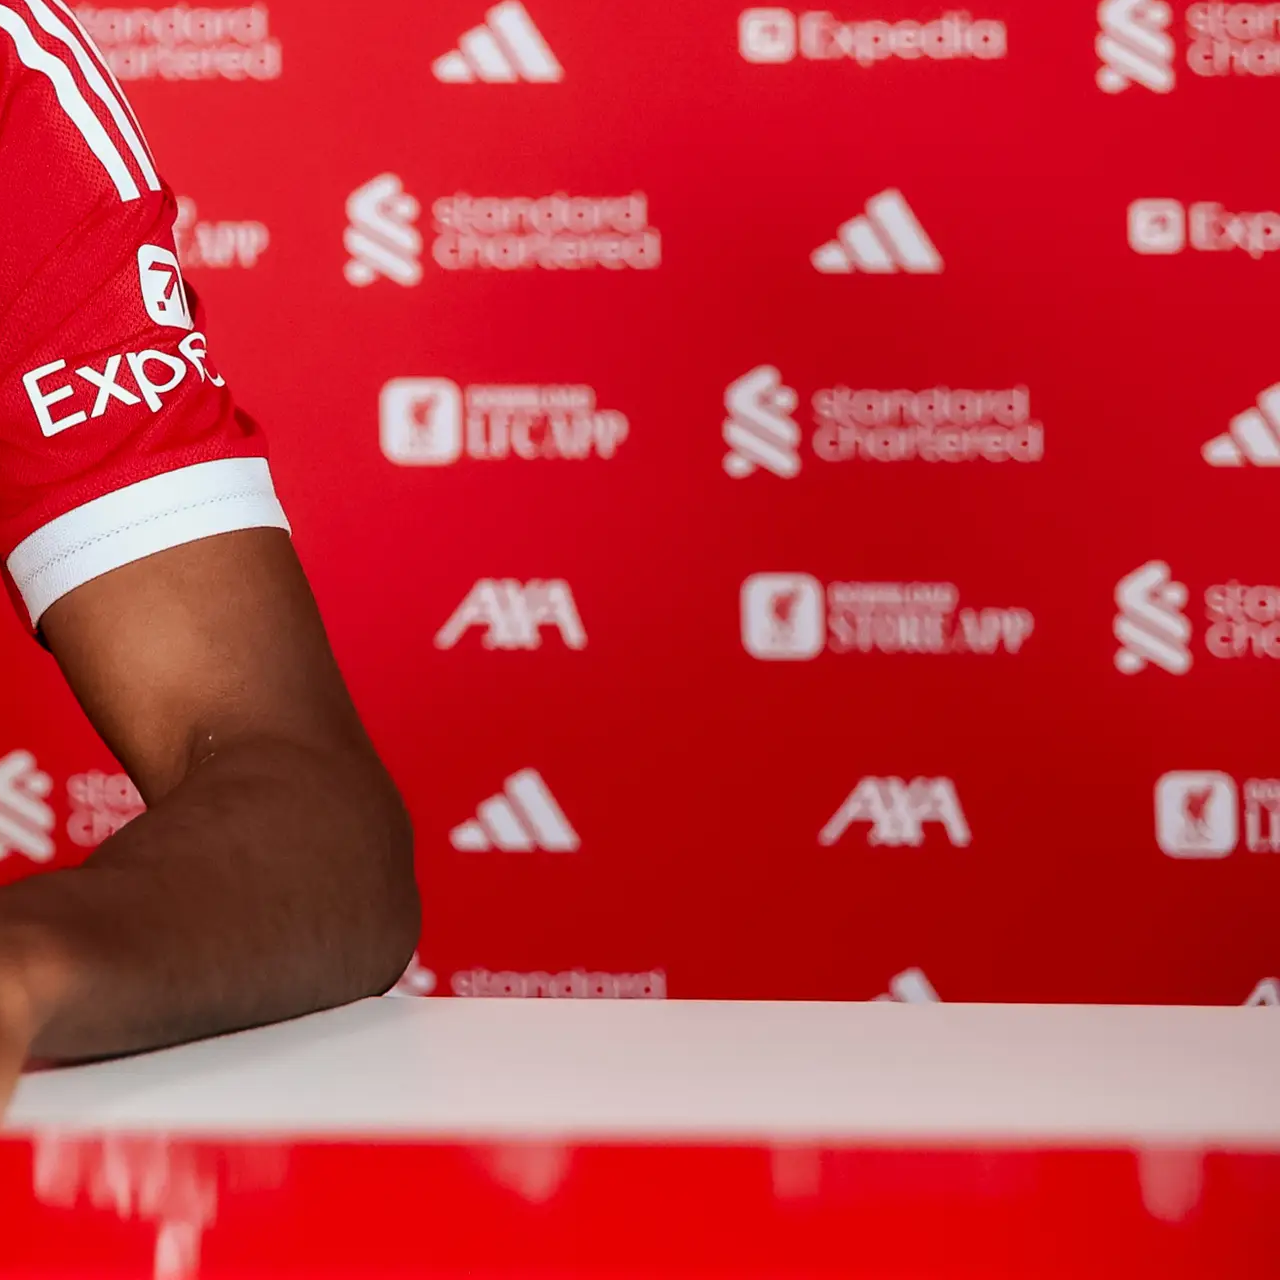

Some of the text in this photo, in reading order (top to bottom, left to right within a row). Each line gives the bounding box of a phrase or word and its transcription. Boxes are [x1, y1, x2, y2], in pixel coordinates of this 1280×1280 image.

[74, 2, 268, 46] tandard
[804, 9, 1008, 68] Expedia
[100, 39, 282, 80] artered
[430, 192, 649, 233] standard
[430, 231, 662, 271] chartered
[22, 331, 226, 438] Expe
[813, 386, 1030, 424] standard
[813, 422, 1044, 462] chartered
[437, 579, 586, 649] AXA
[821, 777, 970, 846] AXA
